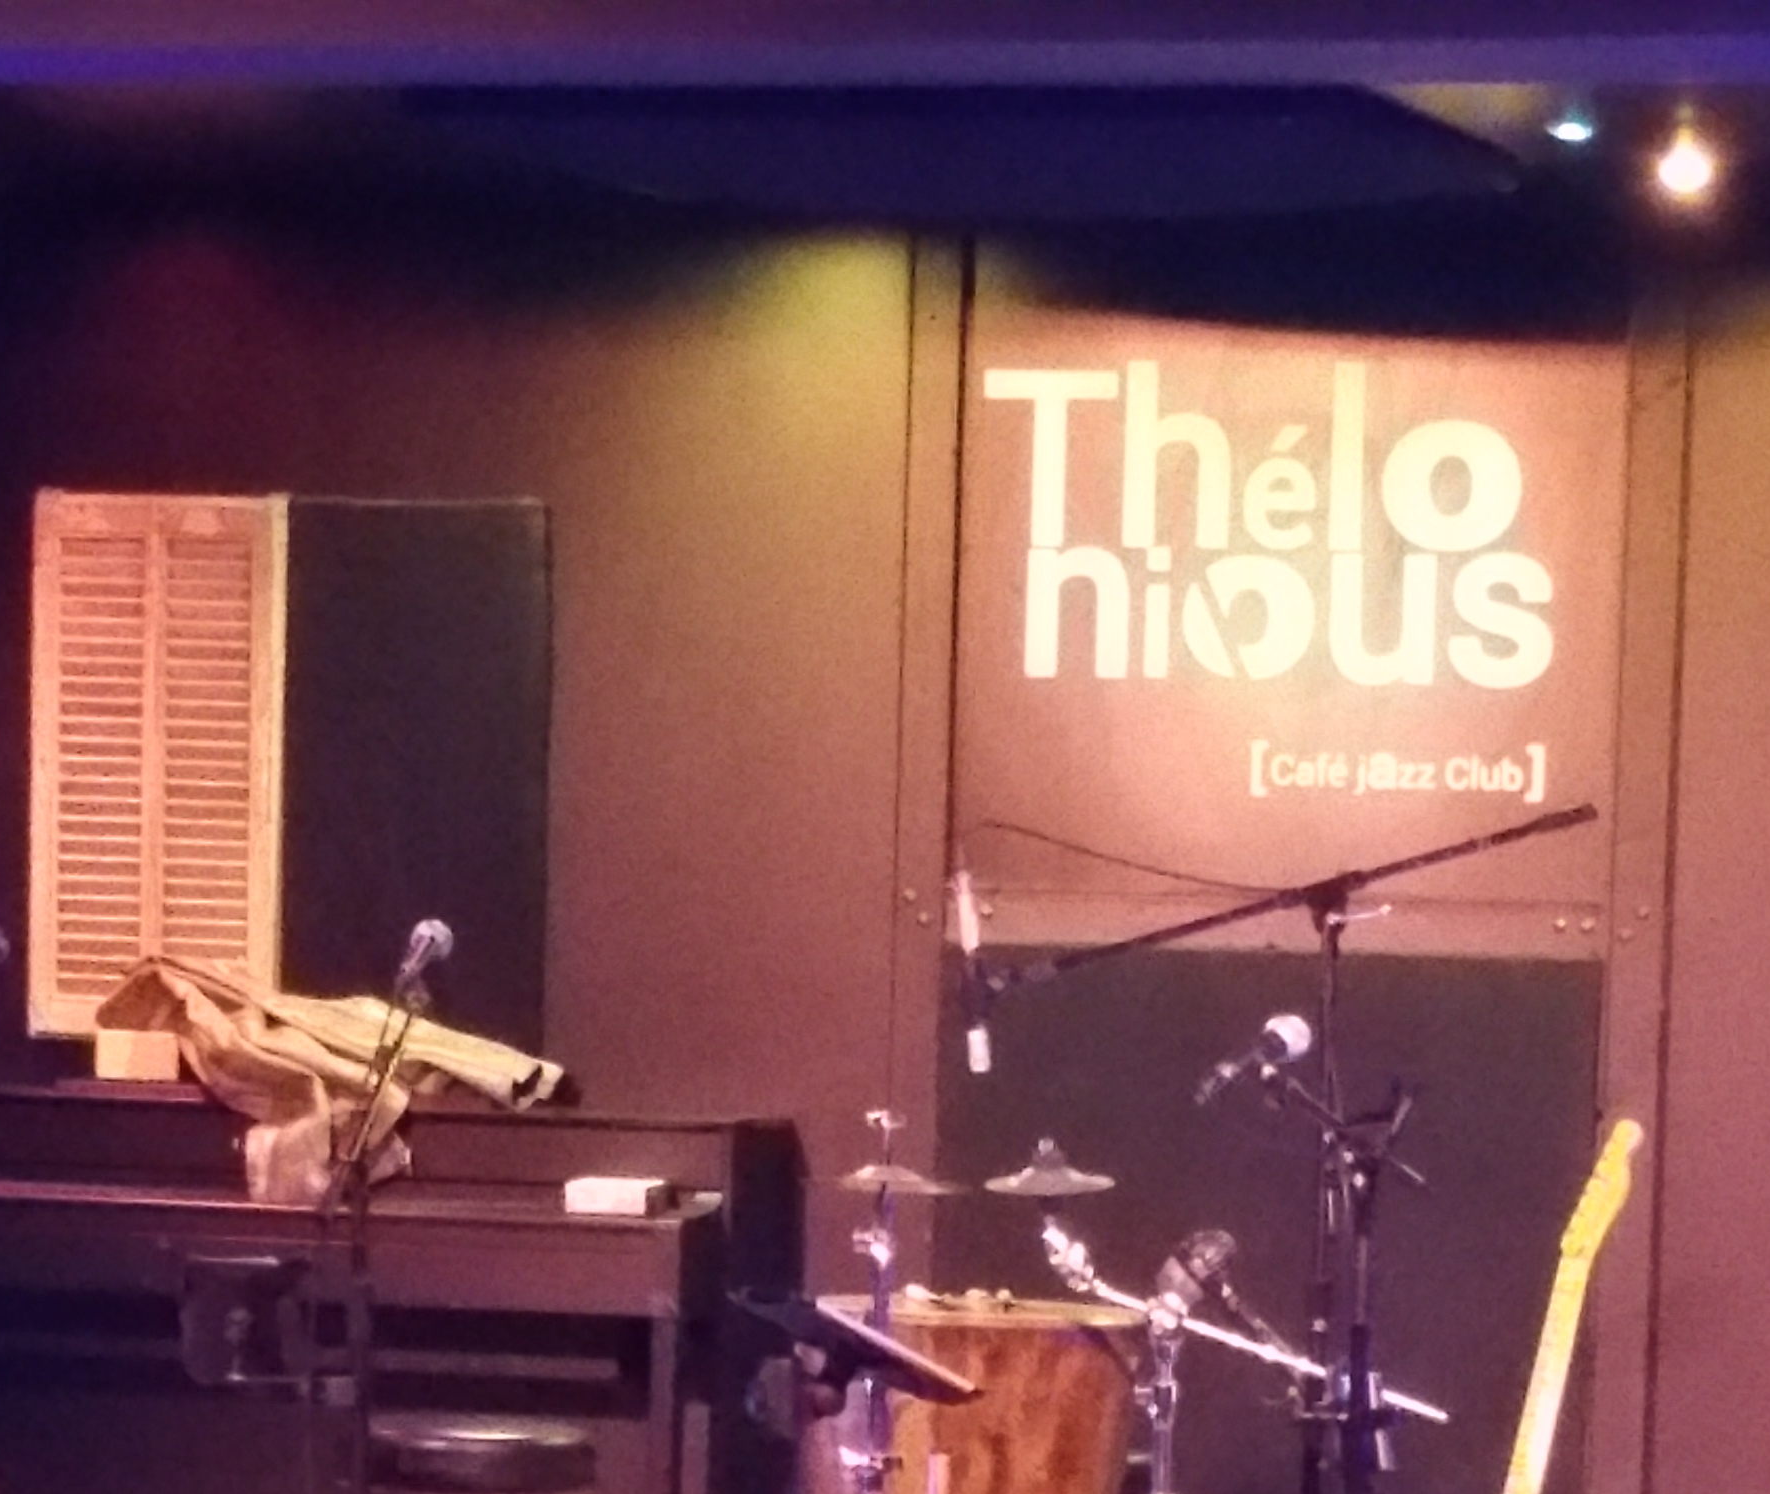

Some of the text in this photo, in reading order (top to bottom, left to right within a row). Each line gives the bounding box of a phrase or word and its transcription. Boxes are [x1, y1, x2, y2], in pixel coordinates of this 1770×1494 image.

[984, 360, 1523, 551] Thélo
[1023, 545, 1554, 689] nious
[1353, 752, 1436, 796] jazz
